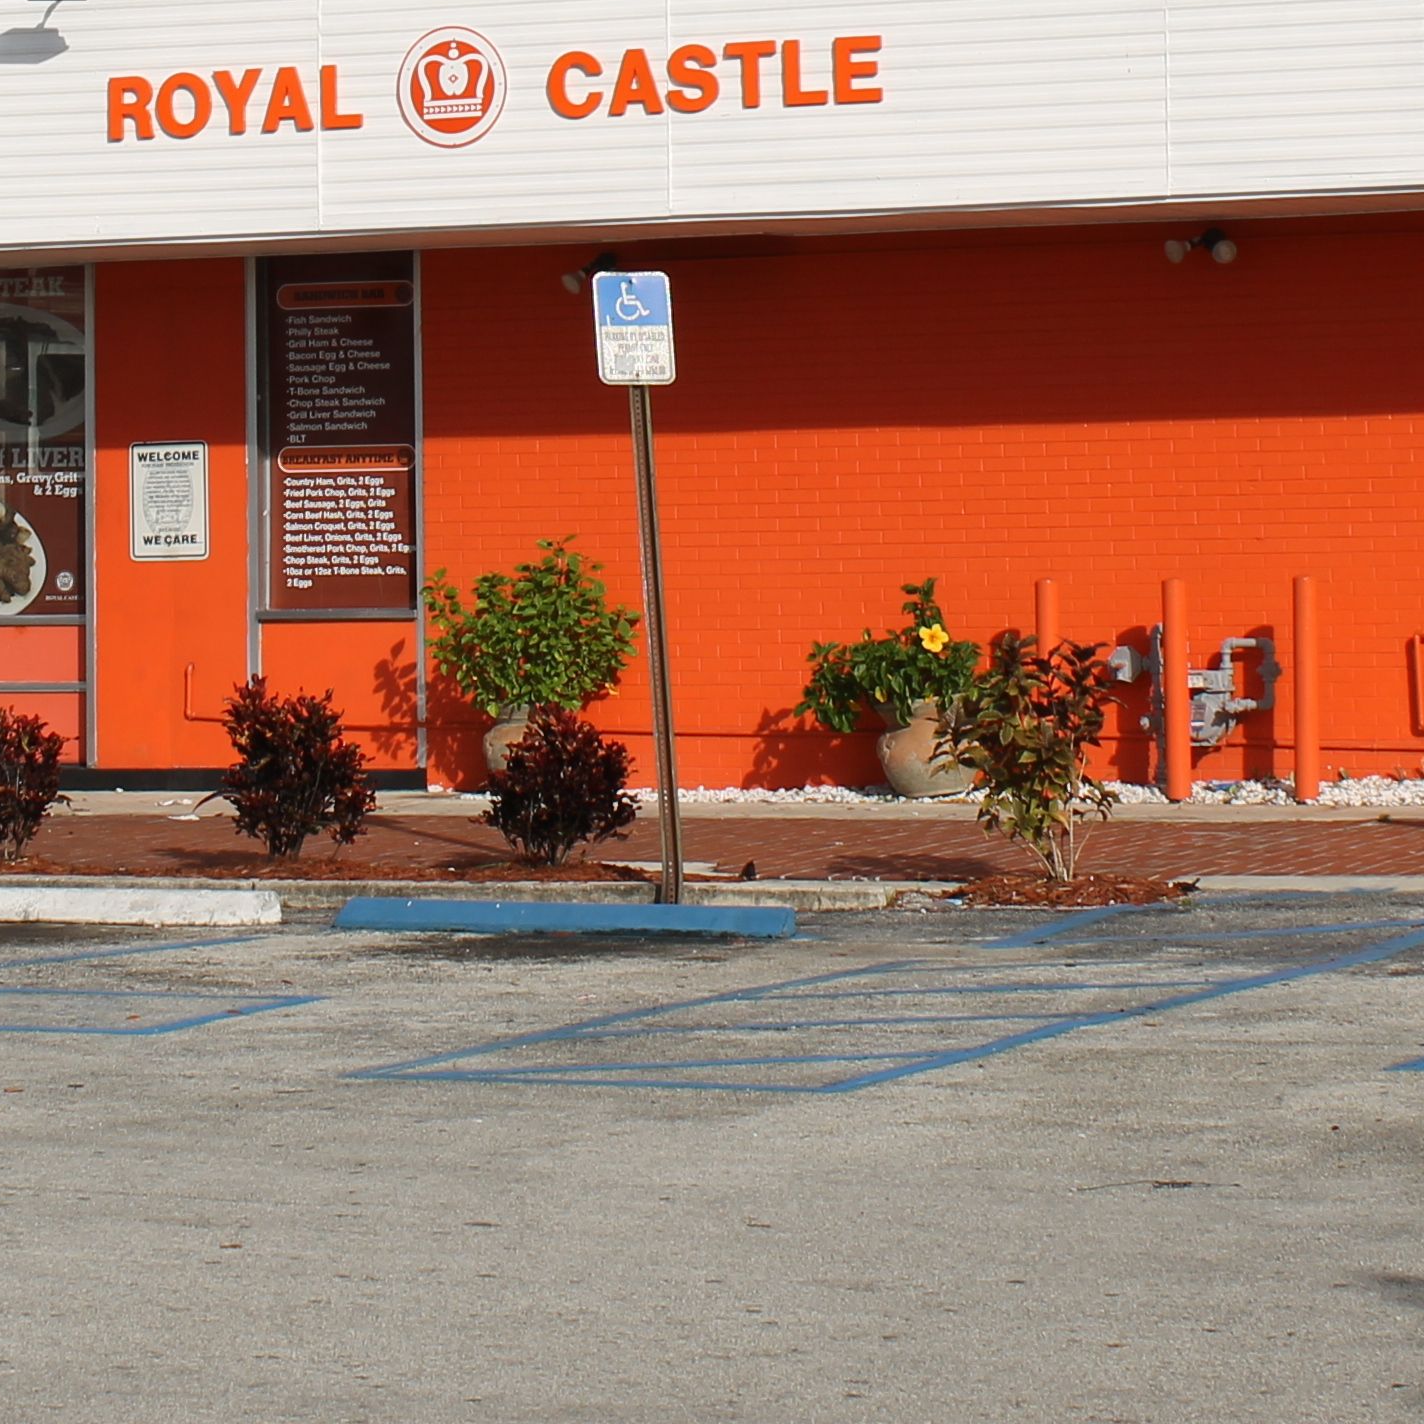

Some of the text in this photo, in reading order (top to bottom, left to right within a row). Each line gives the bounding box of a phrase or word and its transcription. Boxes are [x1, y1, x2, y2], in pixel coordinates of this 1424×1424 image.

[107, 35, 883, 142] ROYAL CASTLE
[288, 315, 352, 324] Fish Sandwich
[288, 327, 339, 337] Philly Steak
[309, 339, 329, 347] Ham
[332, 339, 338, 347] &
[340, 338, 373, 346] Cheese
[289, 350, 381, 361] Bacon Egg & Cheese
[289, 362, 390, 373] Sausage Egg & Cheese
[289, 375, 335, 384] Pork Chop
[290, 386, 365, 395] T-Bone Sandwich
[290, 397, 385, 408] Chop Steak Sandwich
[310, 411, 331, 419] Liver
[333, 409, 376, 418] Sandwich
[290, 422, 368, 431] Salmon Sandwich
[290, 435, 306, 443] BLT
[11, 447, 85, 469] LIVER
[137, 451, 200, 462] WELCOME
[283, 454, 394, 465] BREAKFAST ANYTIME
[286, 478, 314, 487] Country
[359, 477, 364, 485] 2
[365, 476, 384, 486] Eggs
[34, 485, 43, 496] &
[45, 485, 52, 495] 2
[286, 489, 304, 497] Fried
[306, 488, 323, 497] Pork
[370, 488, 375, 496] 2
[377, 488, 395, 497] Eggs
[286, 500, 303, 509] Beef
[339, 500, 344, 508] 2
[286, 512, 304, 520] Corn
[306, 511, 322, 519] Beef
[368, 510, 373, 518] 2
[375, 510, 394, 520] Eggs
[286, 523, 313, 531] Salmon
[370, 522, 374, 530] 2
[376, 522, 395, 531] Eggs
[143, 536, 161, 545] WE
[286, 534, 303, 542] Beef
[377, 533, 381, 541] 2
[384, 532, 402, 542] Eggs
[286, 545, 326, 553] Smothered
[327, 544, 344, 552] Pork
[392, 544, 396, 552] 2
[286, 556, 305, 565] Chop
[354, 555, 358, 563] 2
[360, 555, 379, 565] Eggs
[334, 567, 360, 575] T-Bone
[287, 578, 313, 588] 2 Eggs
